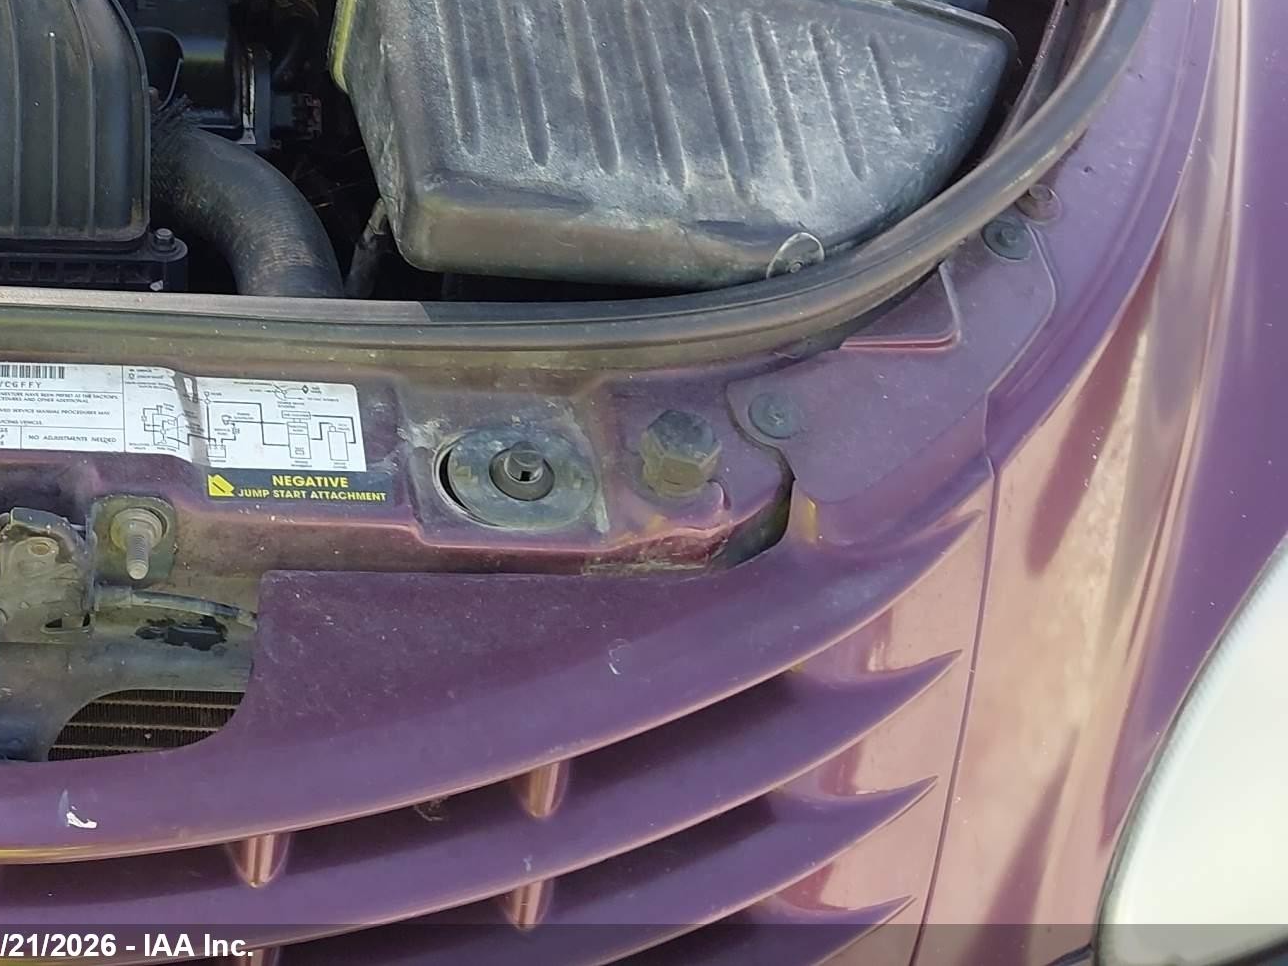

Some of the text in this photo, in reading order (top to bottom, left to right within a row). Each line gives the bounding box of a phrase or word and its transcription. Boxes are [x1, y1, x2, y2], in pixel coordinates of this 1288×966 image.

[271, 474, 348, 488] NEGATIVE
[237, 488, 387, 502] JUMP START ATTACHMENT
